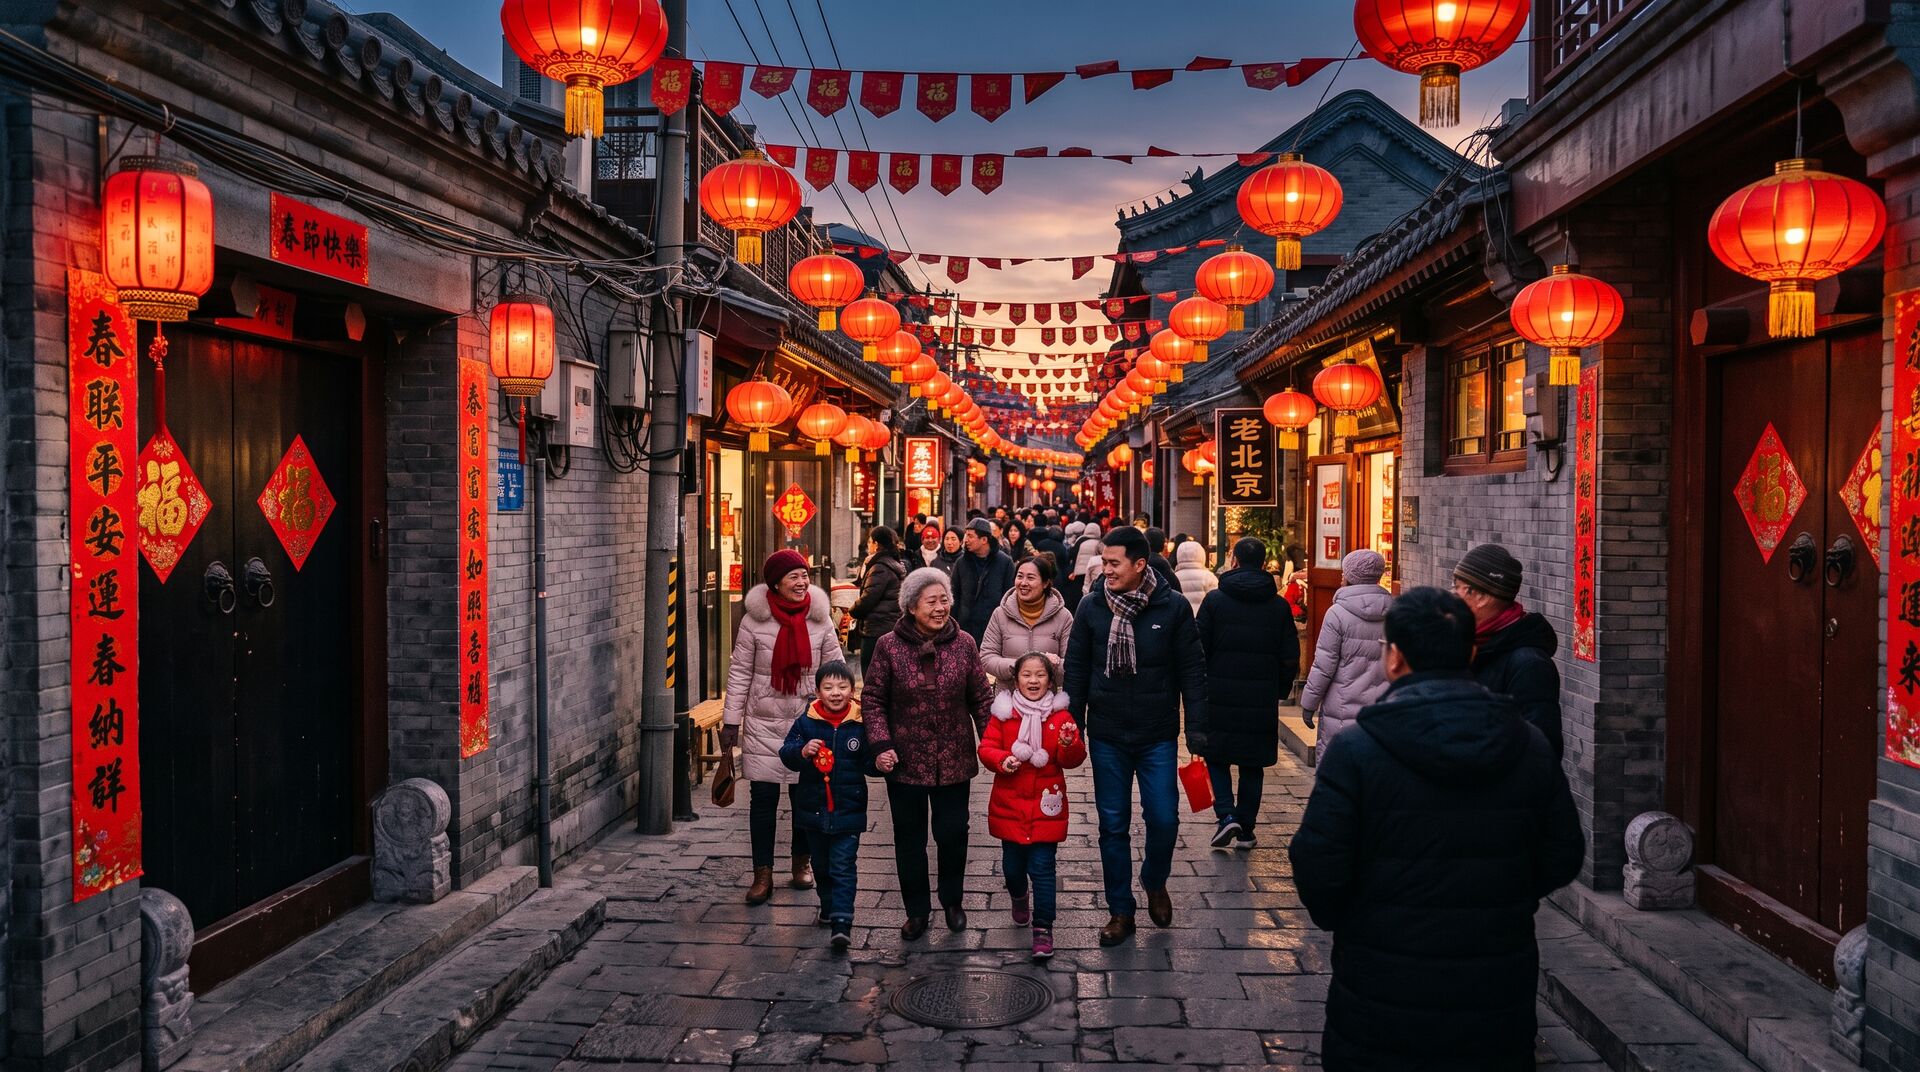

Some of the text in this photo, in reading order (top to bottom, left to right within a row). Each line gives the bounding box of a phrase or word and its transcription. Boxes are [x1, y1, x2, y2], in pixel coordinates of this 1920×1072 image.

[660, 70, 682, 92] 福
[761, 71, 783, 84] 福
[817, 78, 840, 97] 福
[926, 82, 949, 102] 福
[812, 156, 830, 173] 福
[896, 160, 913, 177] 福
[979, 161, 996, 177] 福
[279, 211, 362, 269] 春節快樂
[1230, 417, 1263, 497] 老北京
[137, 459, 188, 537] 福
[279, 463, 316, 532] 福
[1752, 452, 1787, 523] 福
[782, 493, 808, 523] 福
